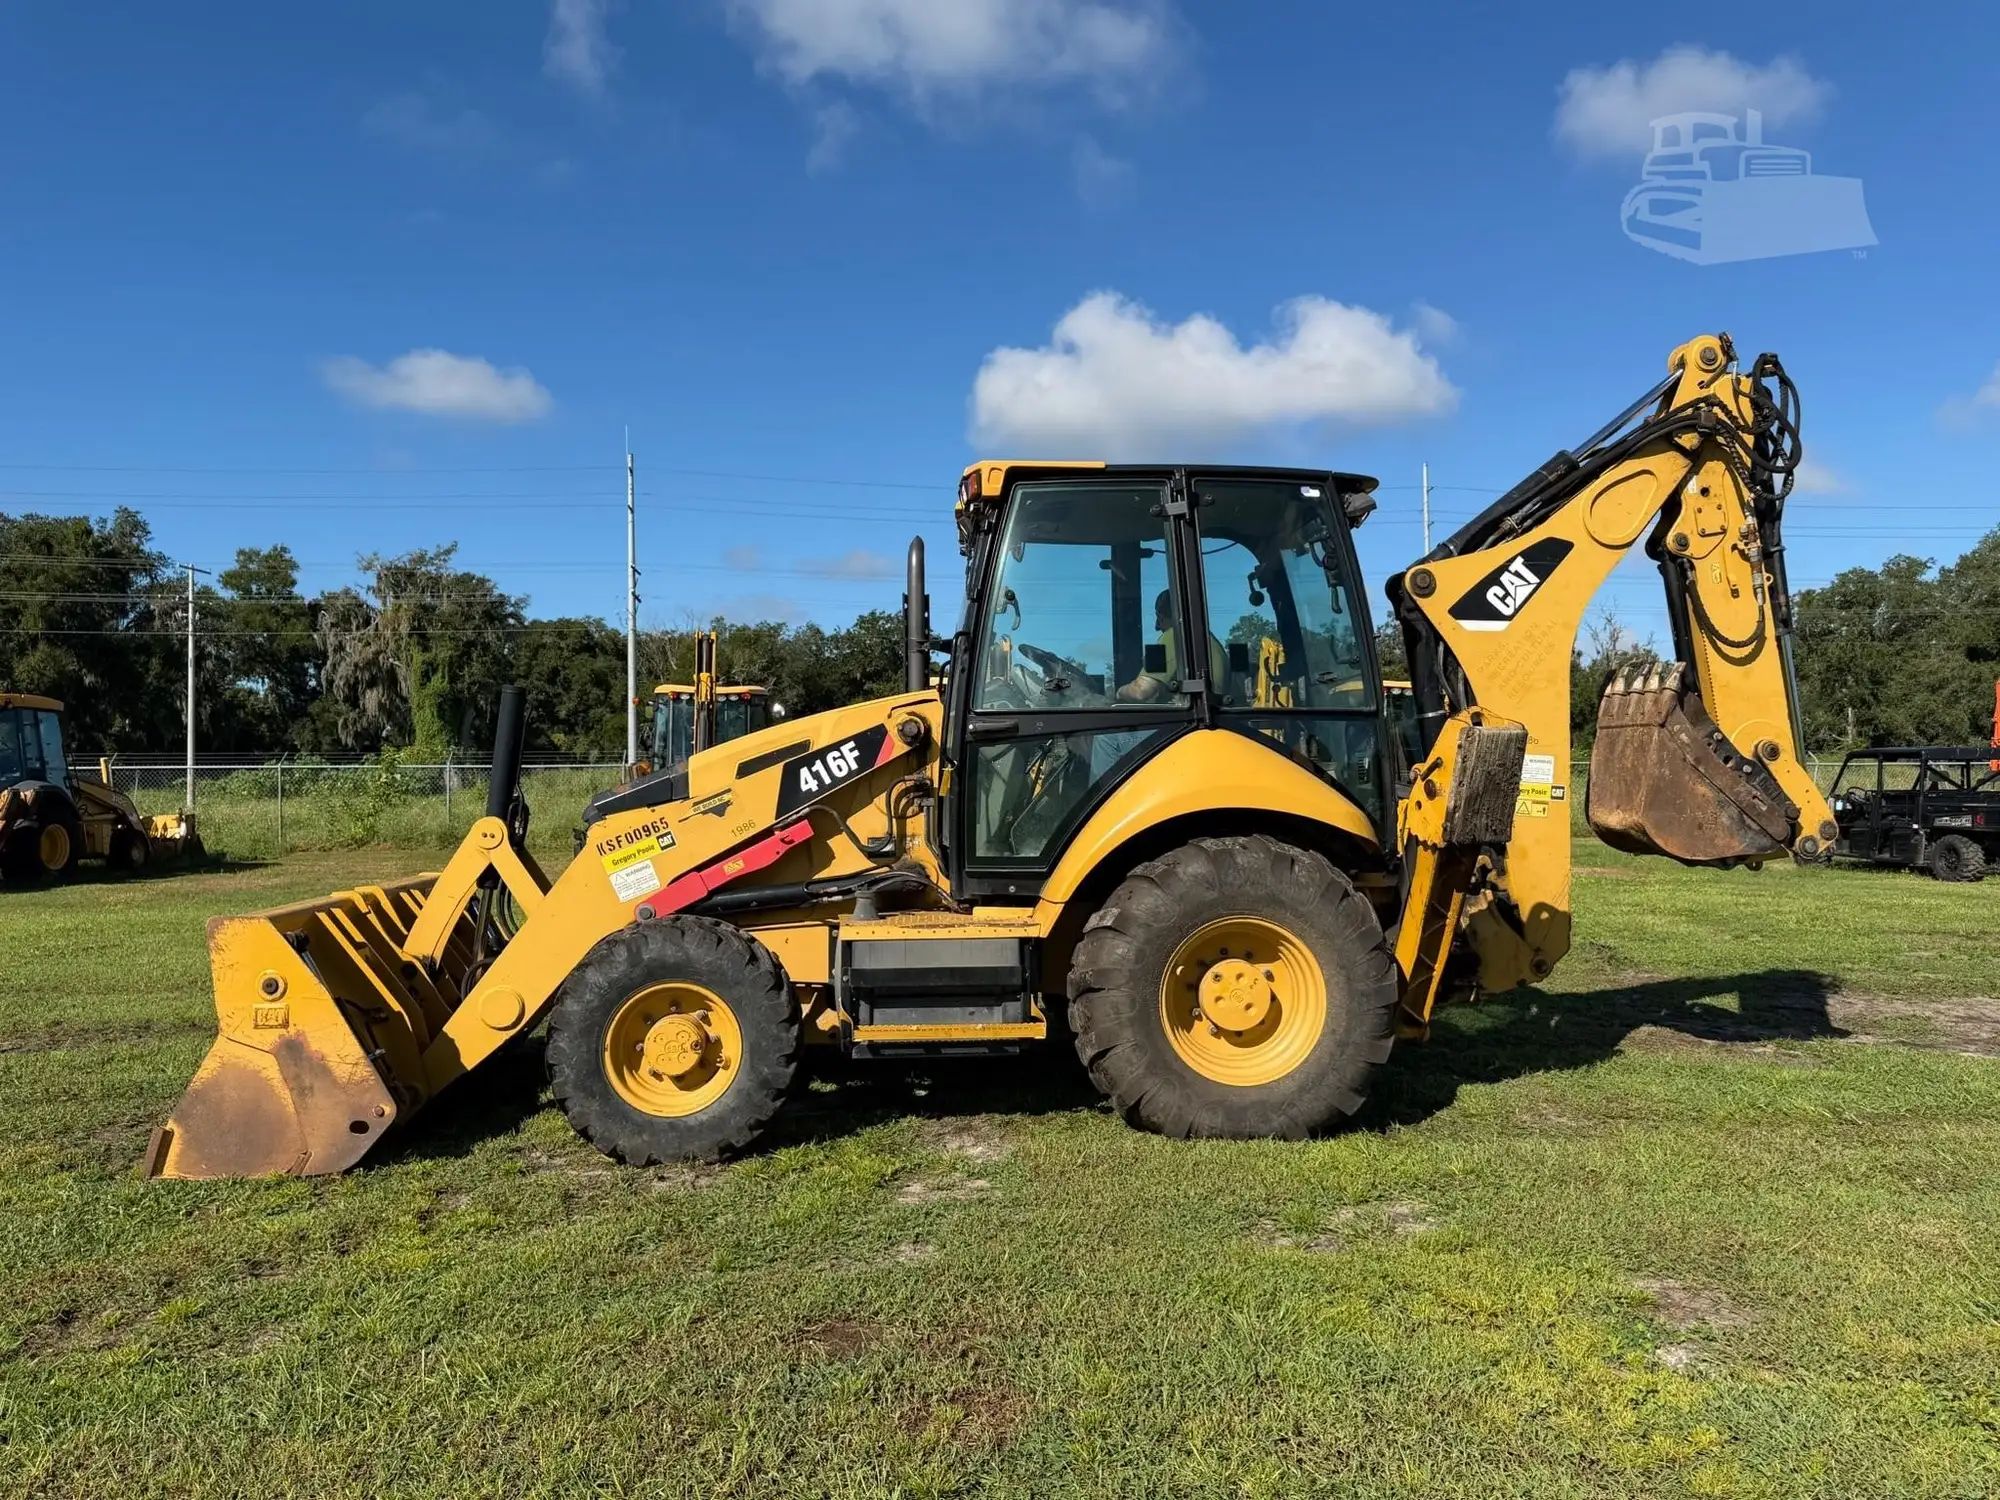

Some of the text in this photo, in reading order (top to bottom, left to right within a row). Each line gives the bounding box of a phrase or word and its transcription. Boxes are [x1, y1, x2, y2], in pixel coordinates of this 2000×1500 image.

[1486, 555, 1541, 616] CAT
[799, 740, 860, 792] 416F
[596, 816, 669, 856] KSF00965
[659, 834, 673, 848] CAT
[731, 819, 757, 837] 1986
[612, 844, 656, 866] Gregory Poole
